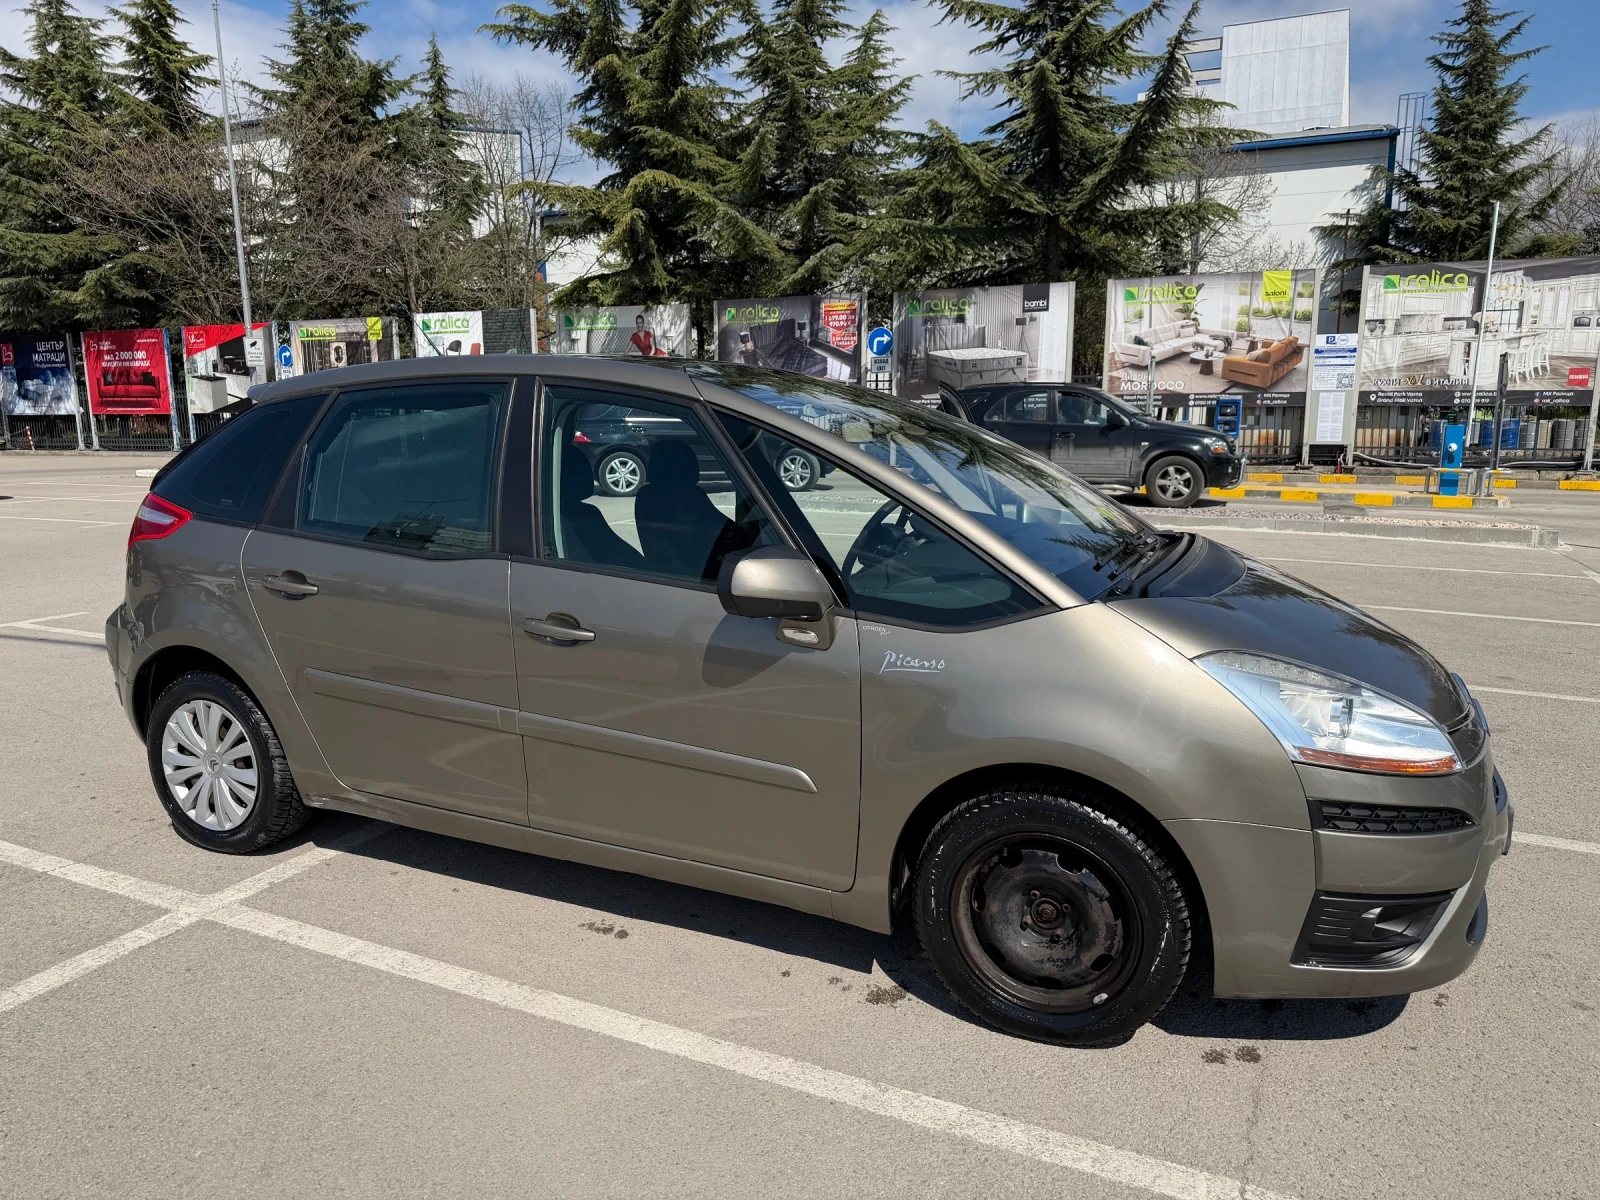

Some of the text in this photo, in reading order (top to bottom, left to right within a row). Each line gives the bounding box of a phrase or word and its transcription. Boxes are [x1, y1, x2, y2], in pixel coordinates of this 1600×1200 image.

[1405, 268, 1469, 287] ralica
[1143, 282, 1197, 299] ralica
[1265, 289, 1287, 297] saloni
[923, 295, 970, 310] ralica
[1024, 298, 1047, 307] bambi
[740, 303, 779, 319] ralica
[434, 315, 470, 329] ralica
[308, 324, 336, 337] ralica
[36, 340, 64, 352] ЦЕНТЪР
[32, 352, 66, 362] МАТРАЦИ
[115, 352, 120, 360] 2
[1373, 378, 1400, 386] КУХНИ
[1433, 378, 1469, 386] ИТАЛИЯ
[879, 650, 946, 675] Picasso
